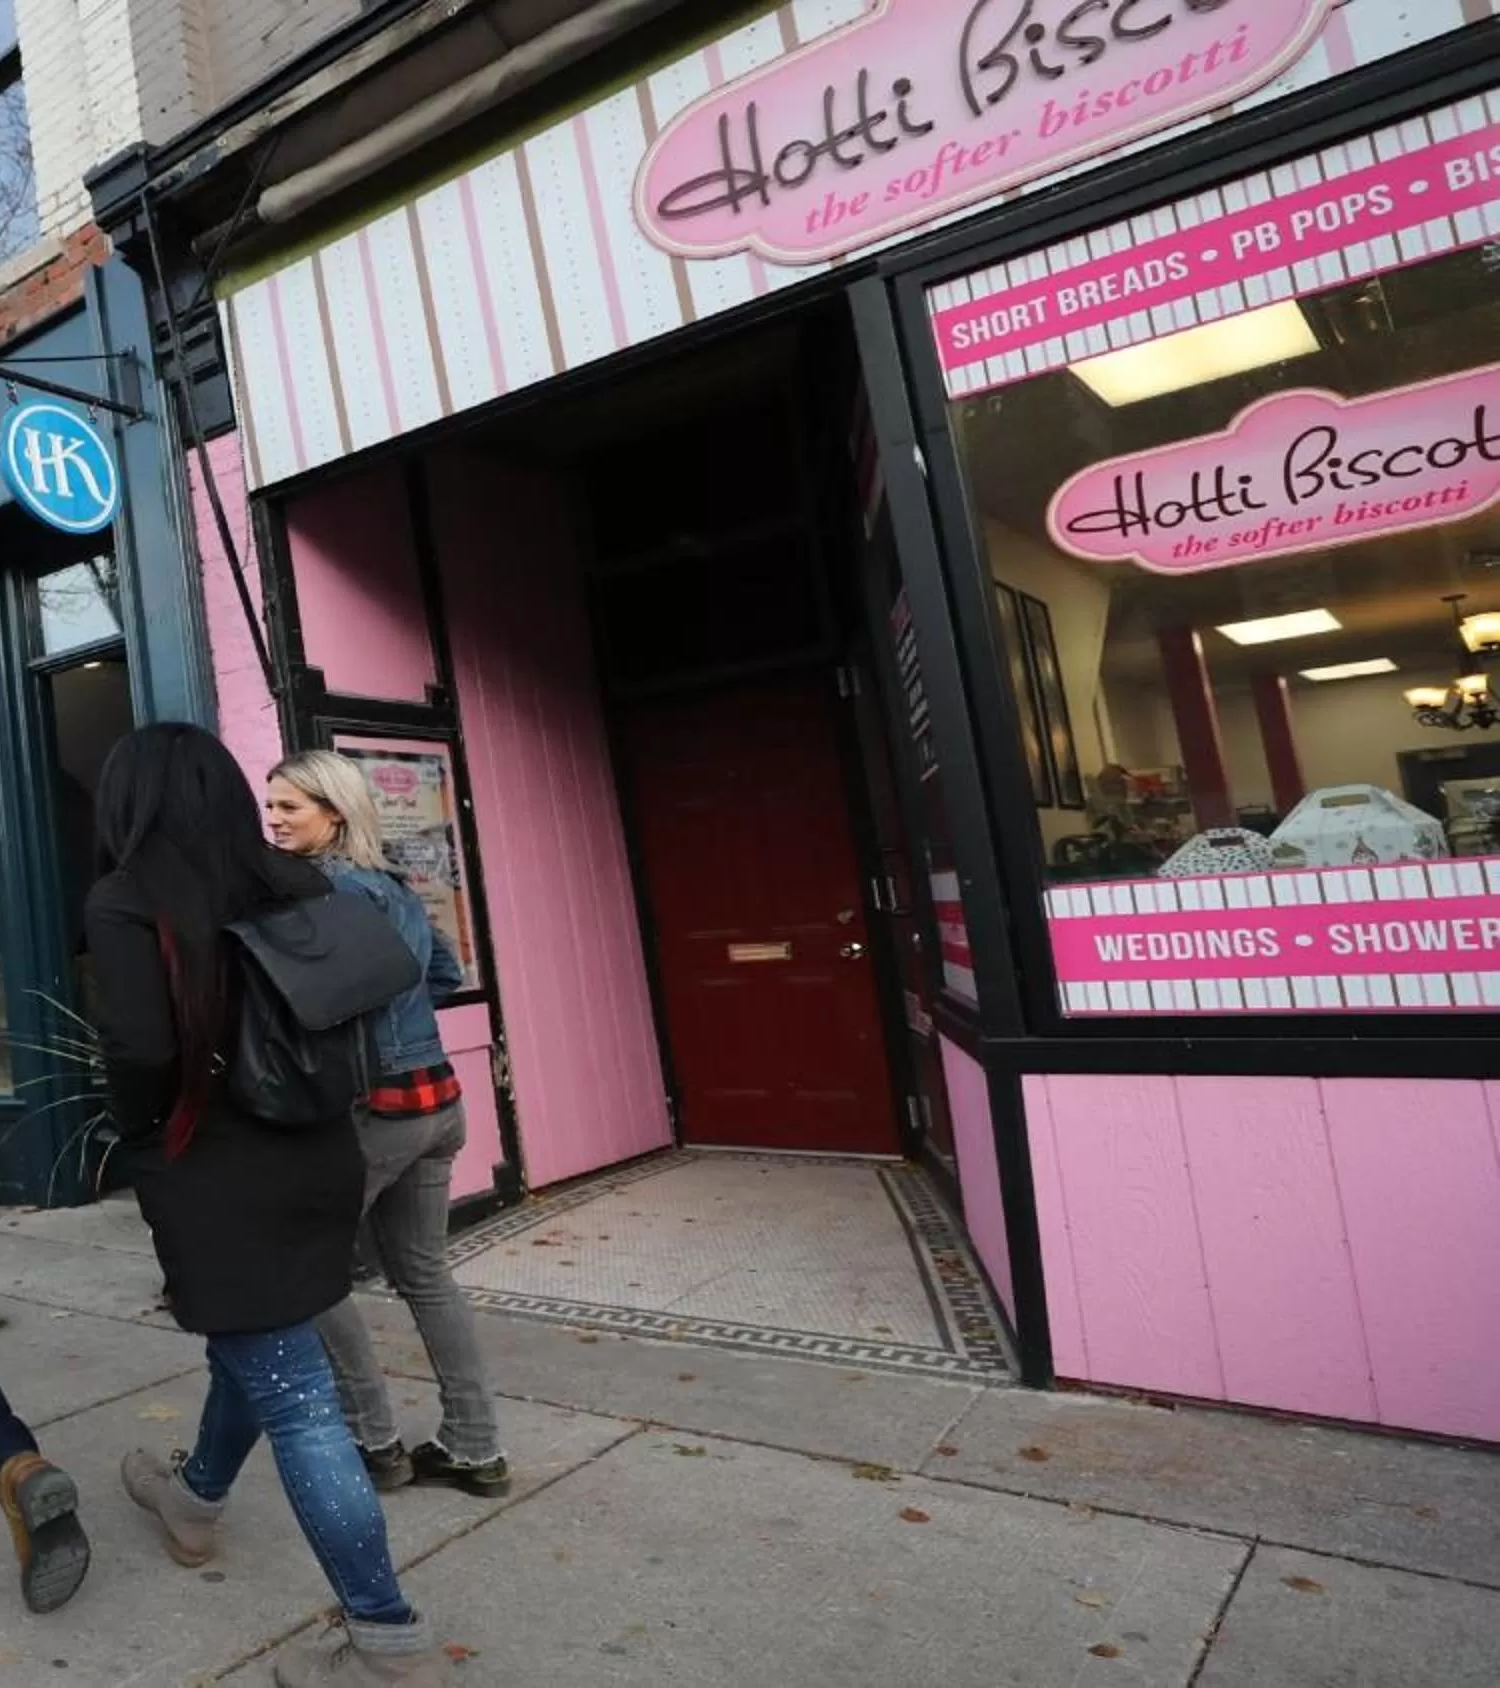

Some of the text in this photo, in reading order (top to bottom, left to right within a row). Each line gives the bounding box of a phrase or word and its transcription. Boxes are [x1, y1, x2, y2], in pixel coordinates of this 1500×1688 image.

[657, 0, 1230, 219] Hotti Bisc
[803, 24, 1252, 234] the softer biscotti
[951, 296, 1048, 349] SHORT
[1056, 250, 1190, 316] BREADS
[1231, 220, 1281, 260] PB
[1290, 184, 1394, 241] POPS
[23, 426, 111, 507] HK
[1066, 465, 1268, 538] Hotti
[1171, 480, 1470, 559] the softer biscotti
[1094, 926, 1281, 962] WEDDINGS
